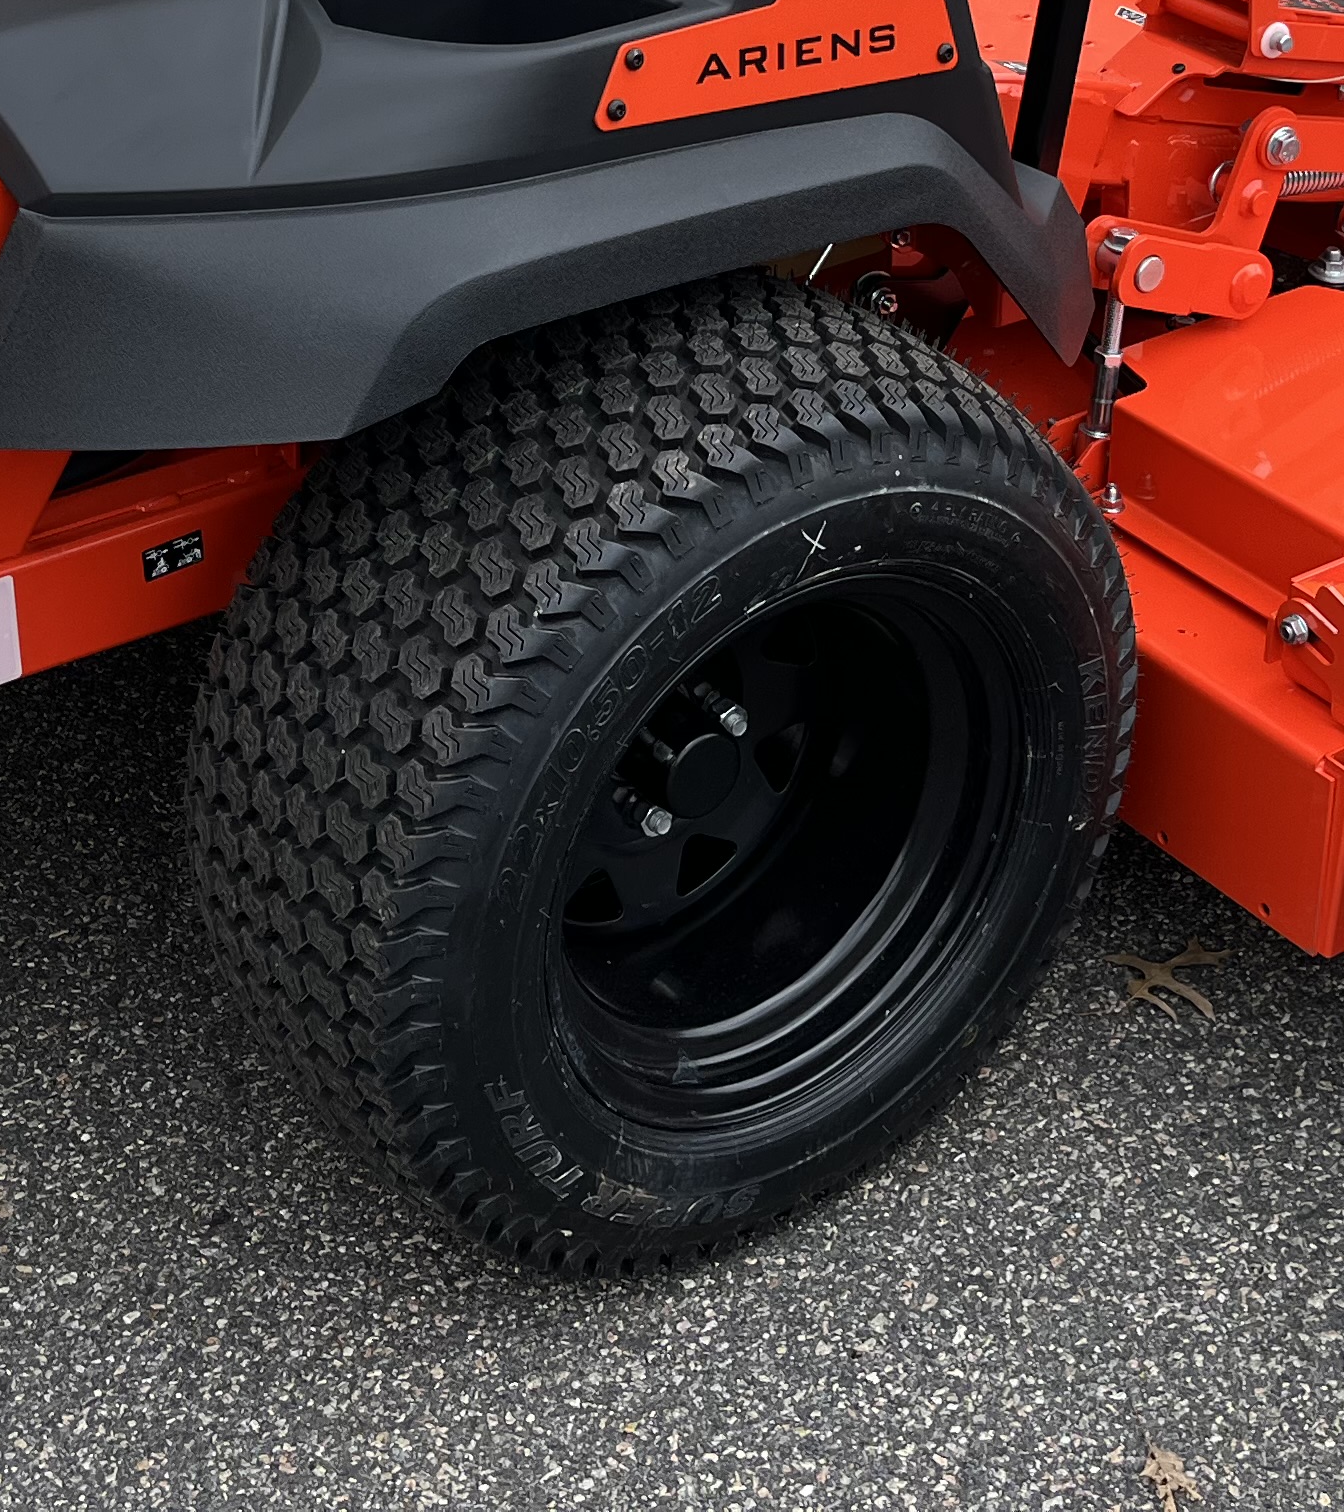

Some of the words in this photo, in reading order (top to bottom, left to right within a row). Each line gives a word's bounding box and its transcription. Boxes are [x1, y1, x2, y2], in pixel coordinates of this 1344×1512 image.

[696, 23, 895, 85] ARIENS
[1072, 652, 1109, 832] KENDA
[483, 1074, 586, 1203] TURF
